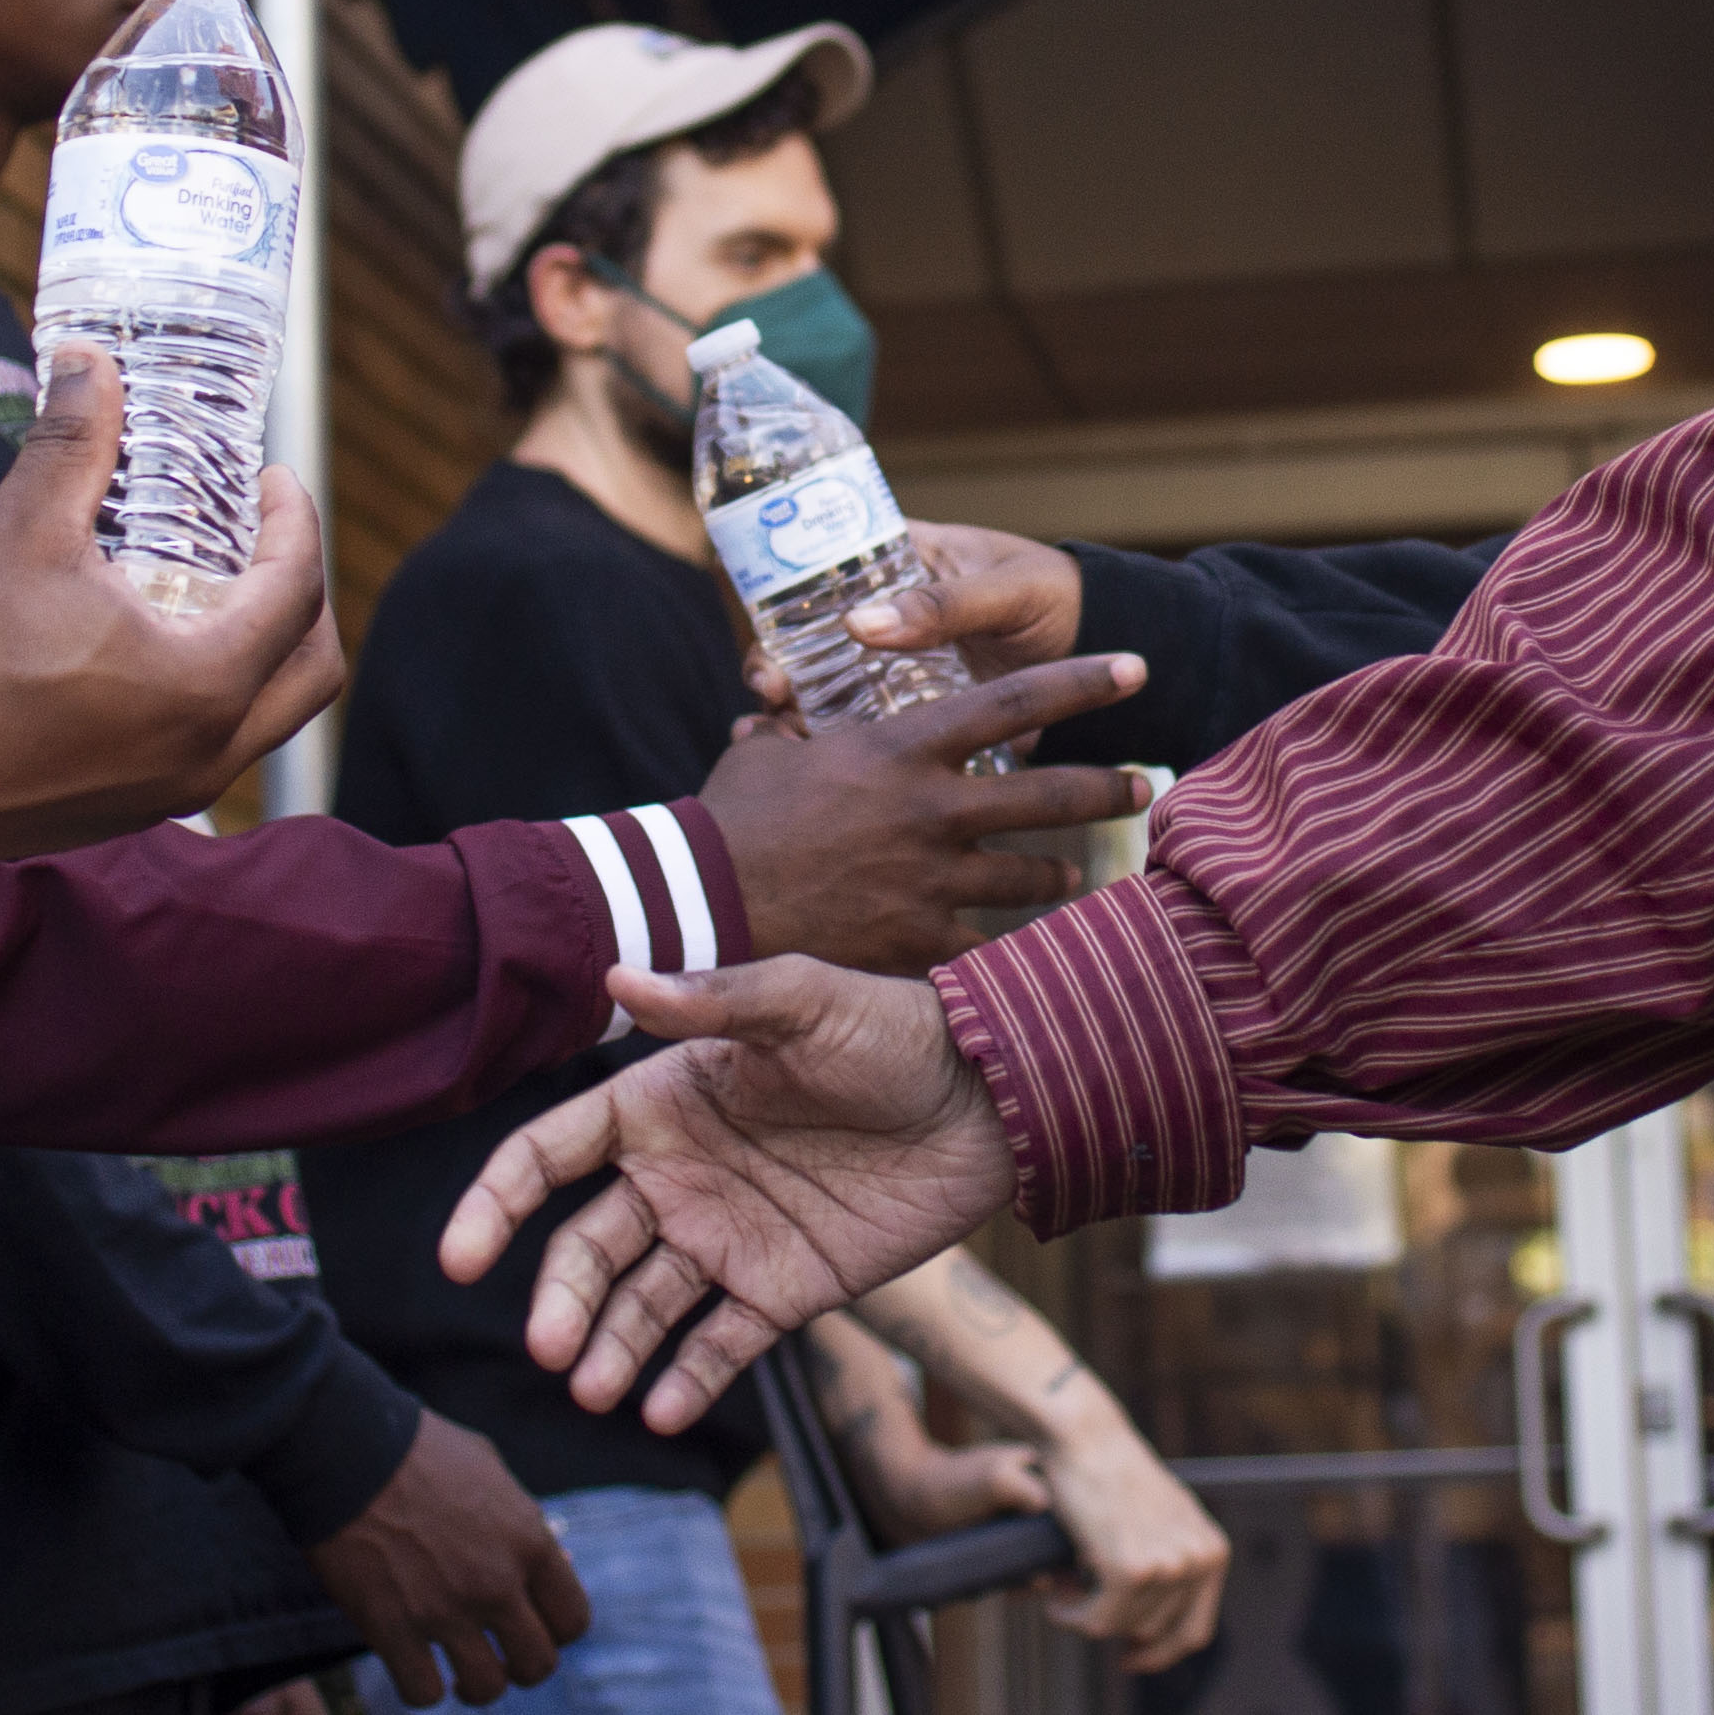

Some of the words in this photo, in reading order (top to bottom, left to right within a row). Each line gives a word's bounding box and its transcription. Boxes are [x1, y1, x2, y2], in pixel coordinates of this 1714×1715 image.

[136, 152, 179, 169] Great
[177, 188, 253, 220] Drinking
[199, 208, 253, 235] Water
